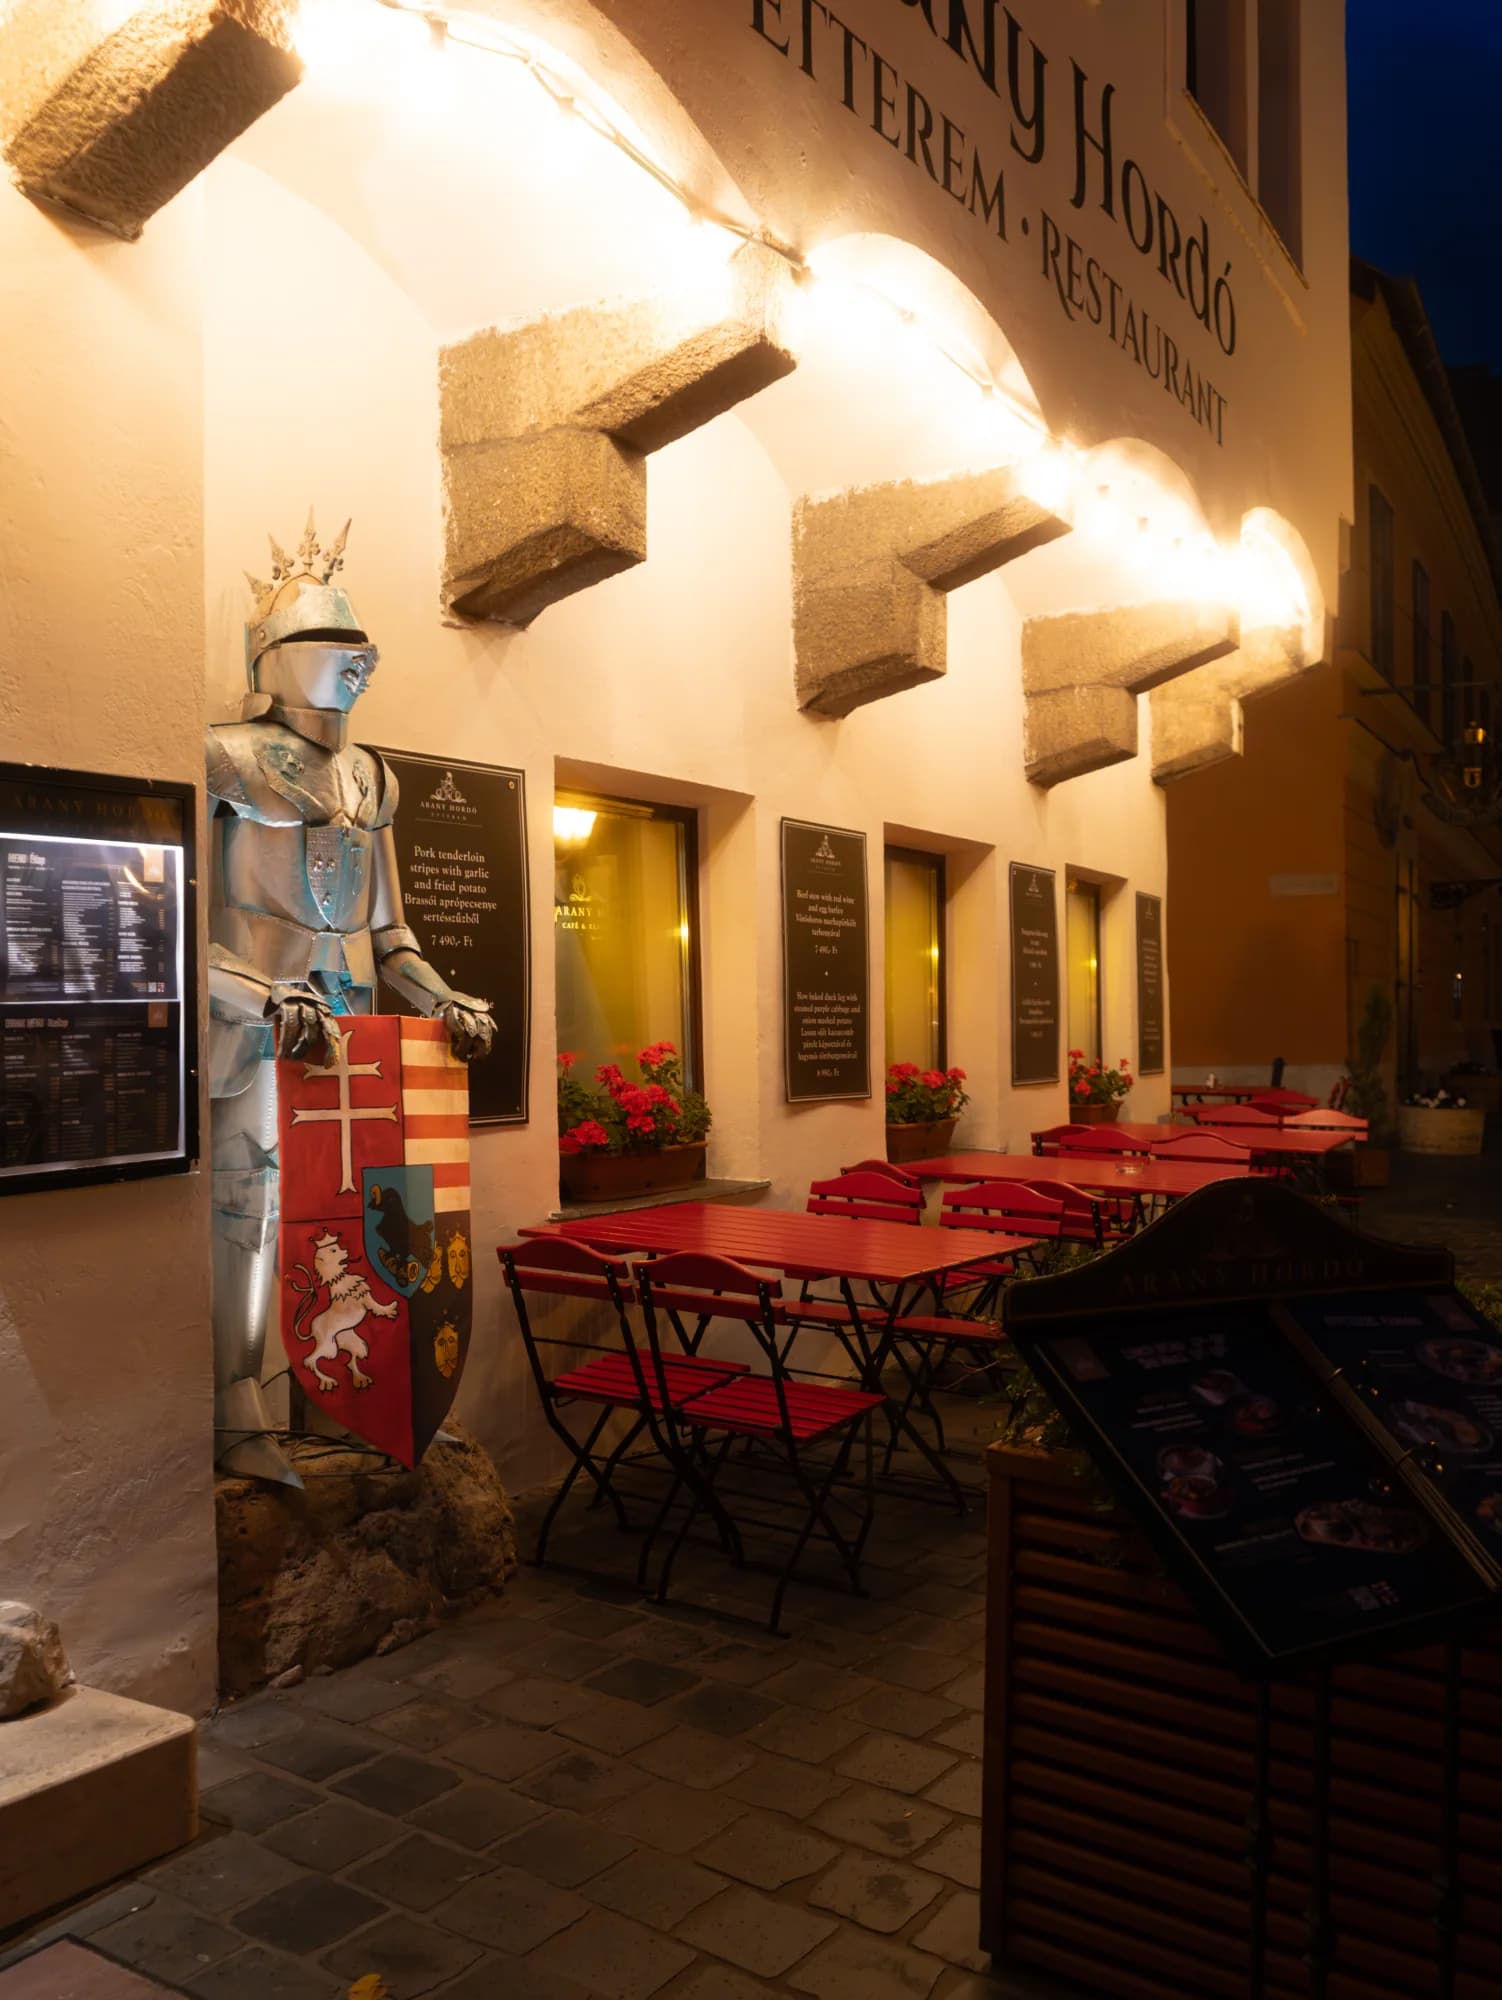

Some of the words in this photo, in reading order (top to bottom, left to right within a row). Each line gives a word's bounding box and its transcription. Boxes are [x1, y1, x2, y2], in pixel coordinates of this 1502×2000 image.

[1041, 208, 1227, 447] RESTAURANT
[414, 845, 436, 858] Pork
[438, 849, 485, 863] tenderloin
[410, 863, 439, 876] stripes
[442, 865, 462, 876] with
[464, 867, 489, 879] garlic
[414, 879, 432, 890] and
[434, 881, 456, 892] fried
[459, 883, 487, 895] potato
[404, 893, 437, 906] Brassói
[439, 897, 497, 912] aprópecsenye
[431, 935, 437, 946] 7
[439, 935, 461, 948] 490,-
[463, 935, 473, 947] Ft
